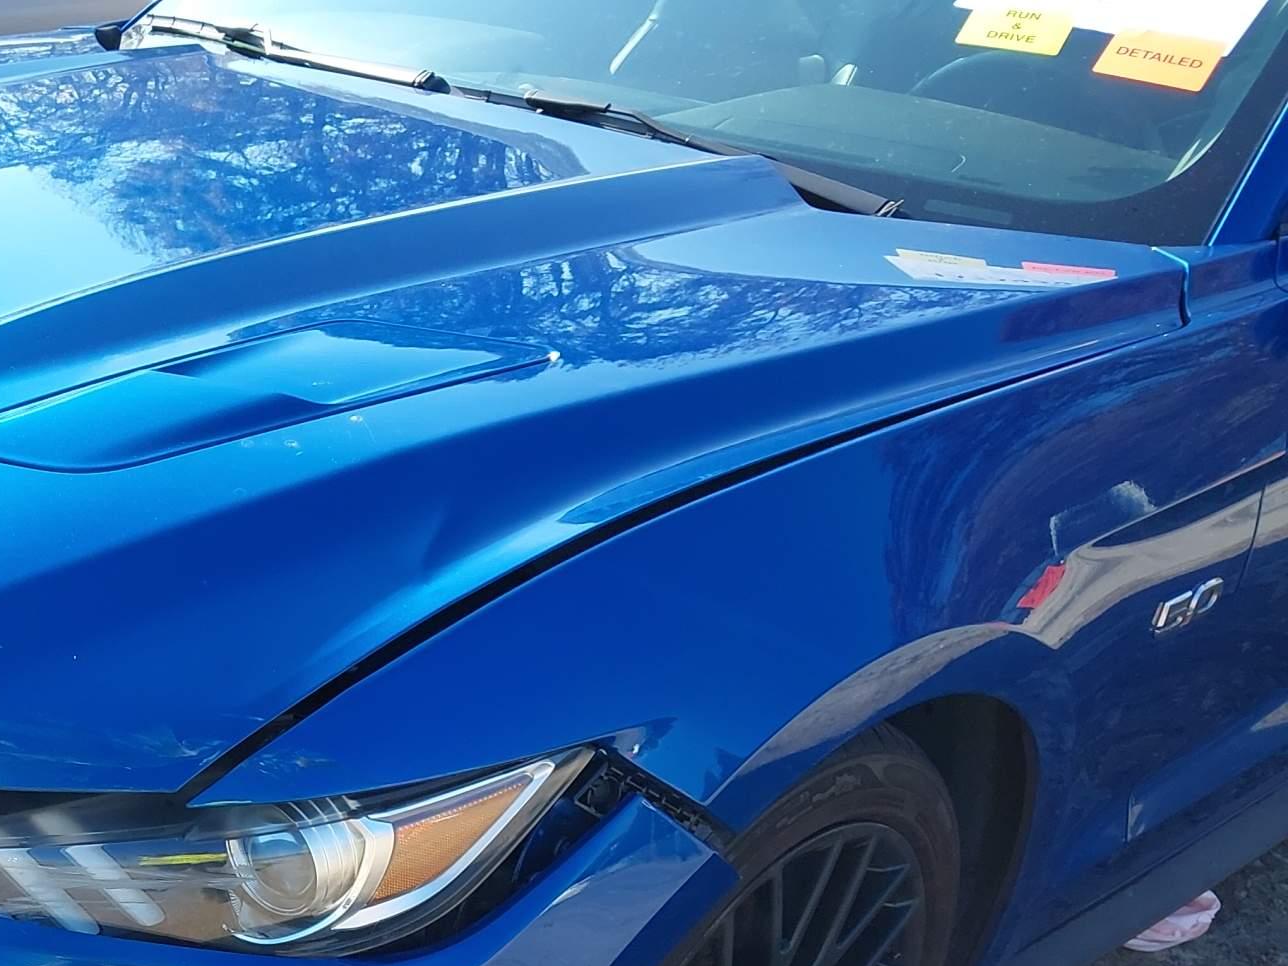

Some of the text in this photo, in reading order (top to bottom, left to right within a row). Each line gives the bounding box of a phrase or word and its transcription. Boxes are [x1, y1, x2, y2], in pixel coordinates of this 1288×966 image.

[1005, 9, 1042, 21] RUN
[1011, 22, 1022, 30] &
[986, 30, 1037, 44] DRIVE
[1116, 46, 1204, 69] DETAILED
